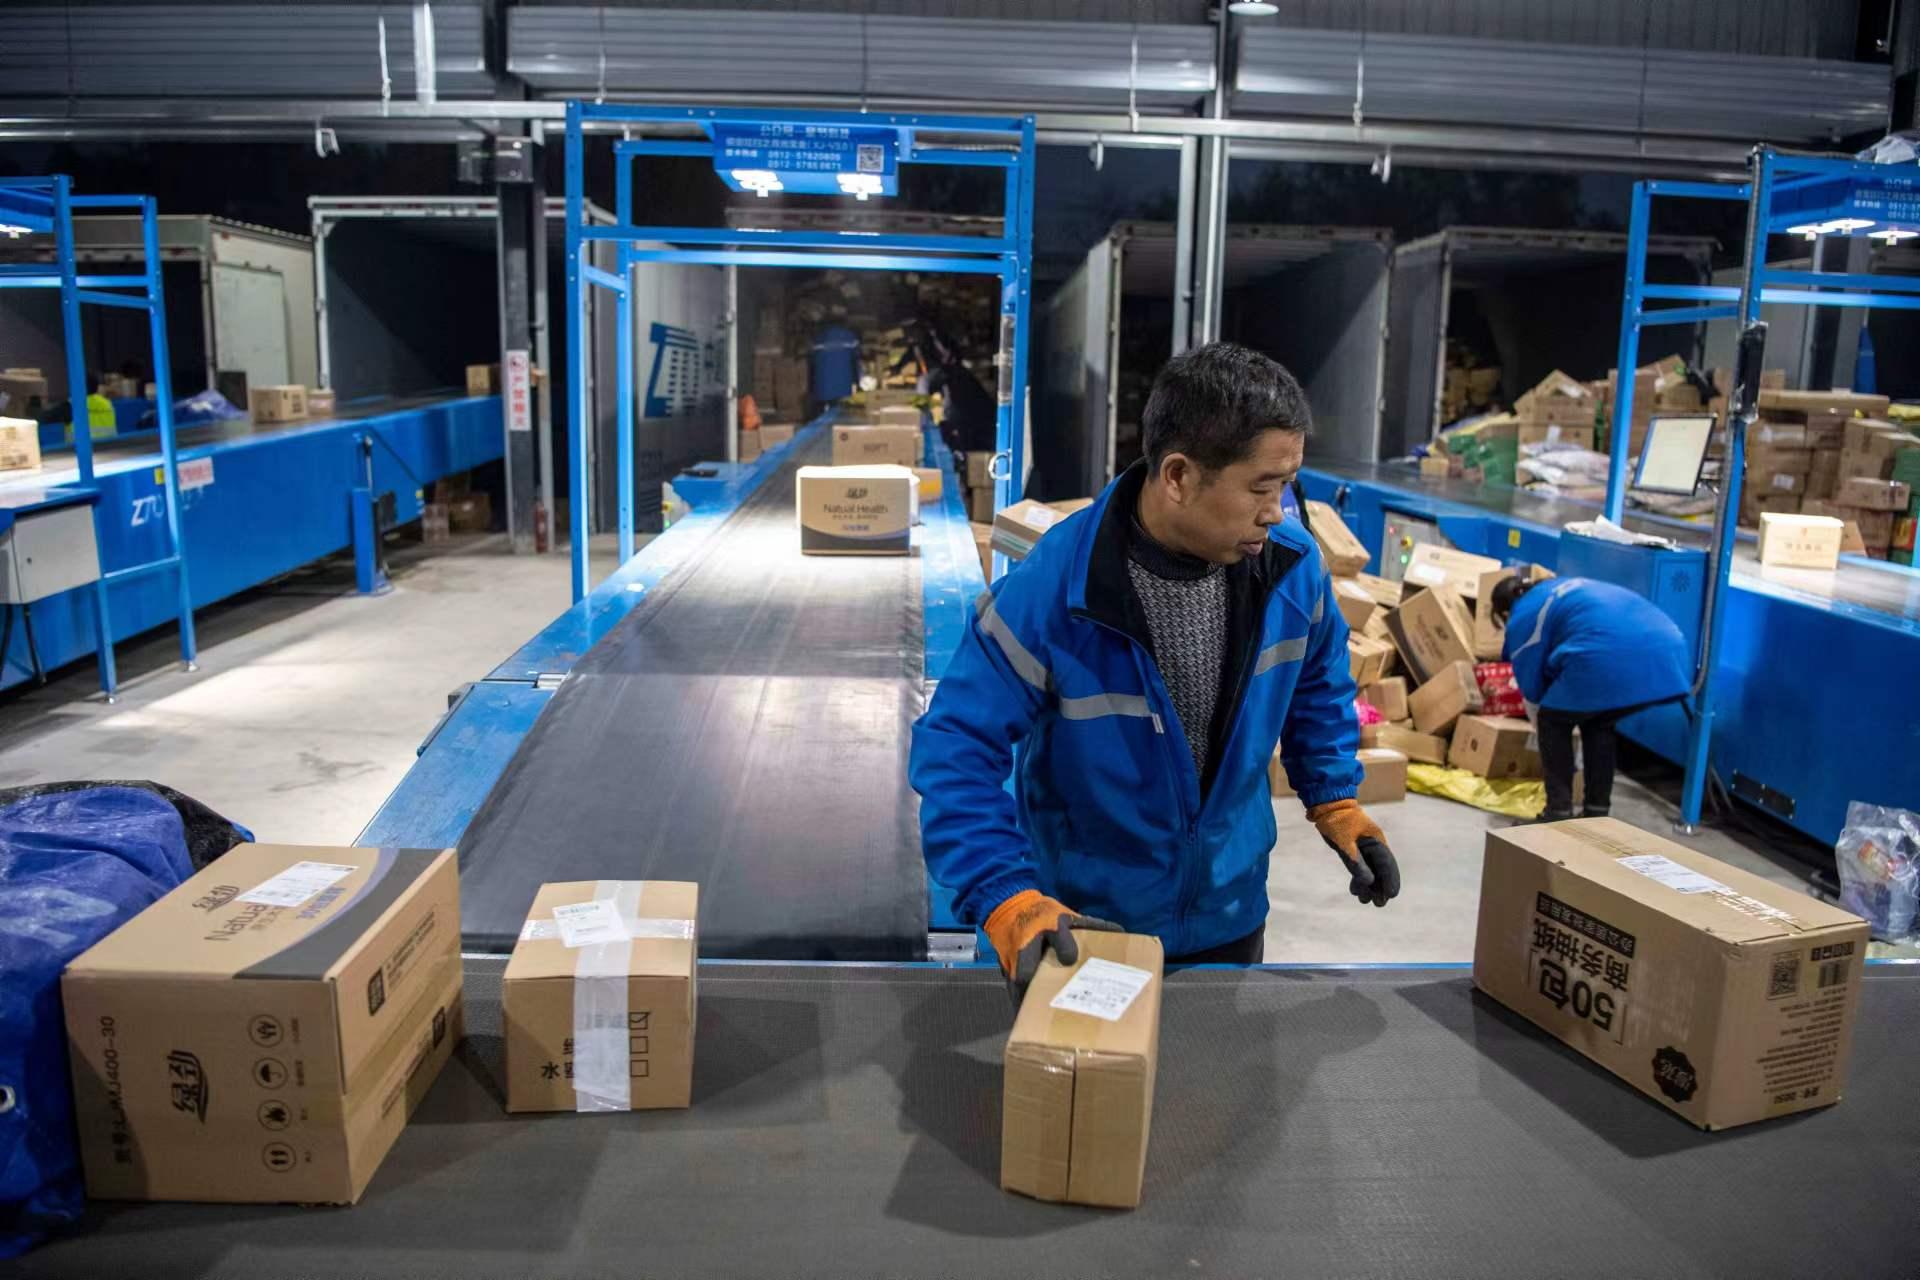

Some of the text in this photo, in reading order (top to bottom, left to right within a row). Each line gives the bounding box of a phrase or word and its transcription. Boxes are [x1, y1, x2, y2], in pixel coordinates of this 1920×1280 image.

[857, 503, 888, 514] Health
[1532, 917, 1632, 993] 商务抽纸
[1537, 960, 1617, 1033] 50包
[166, 1048, 207, 1123] 绿劲
